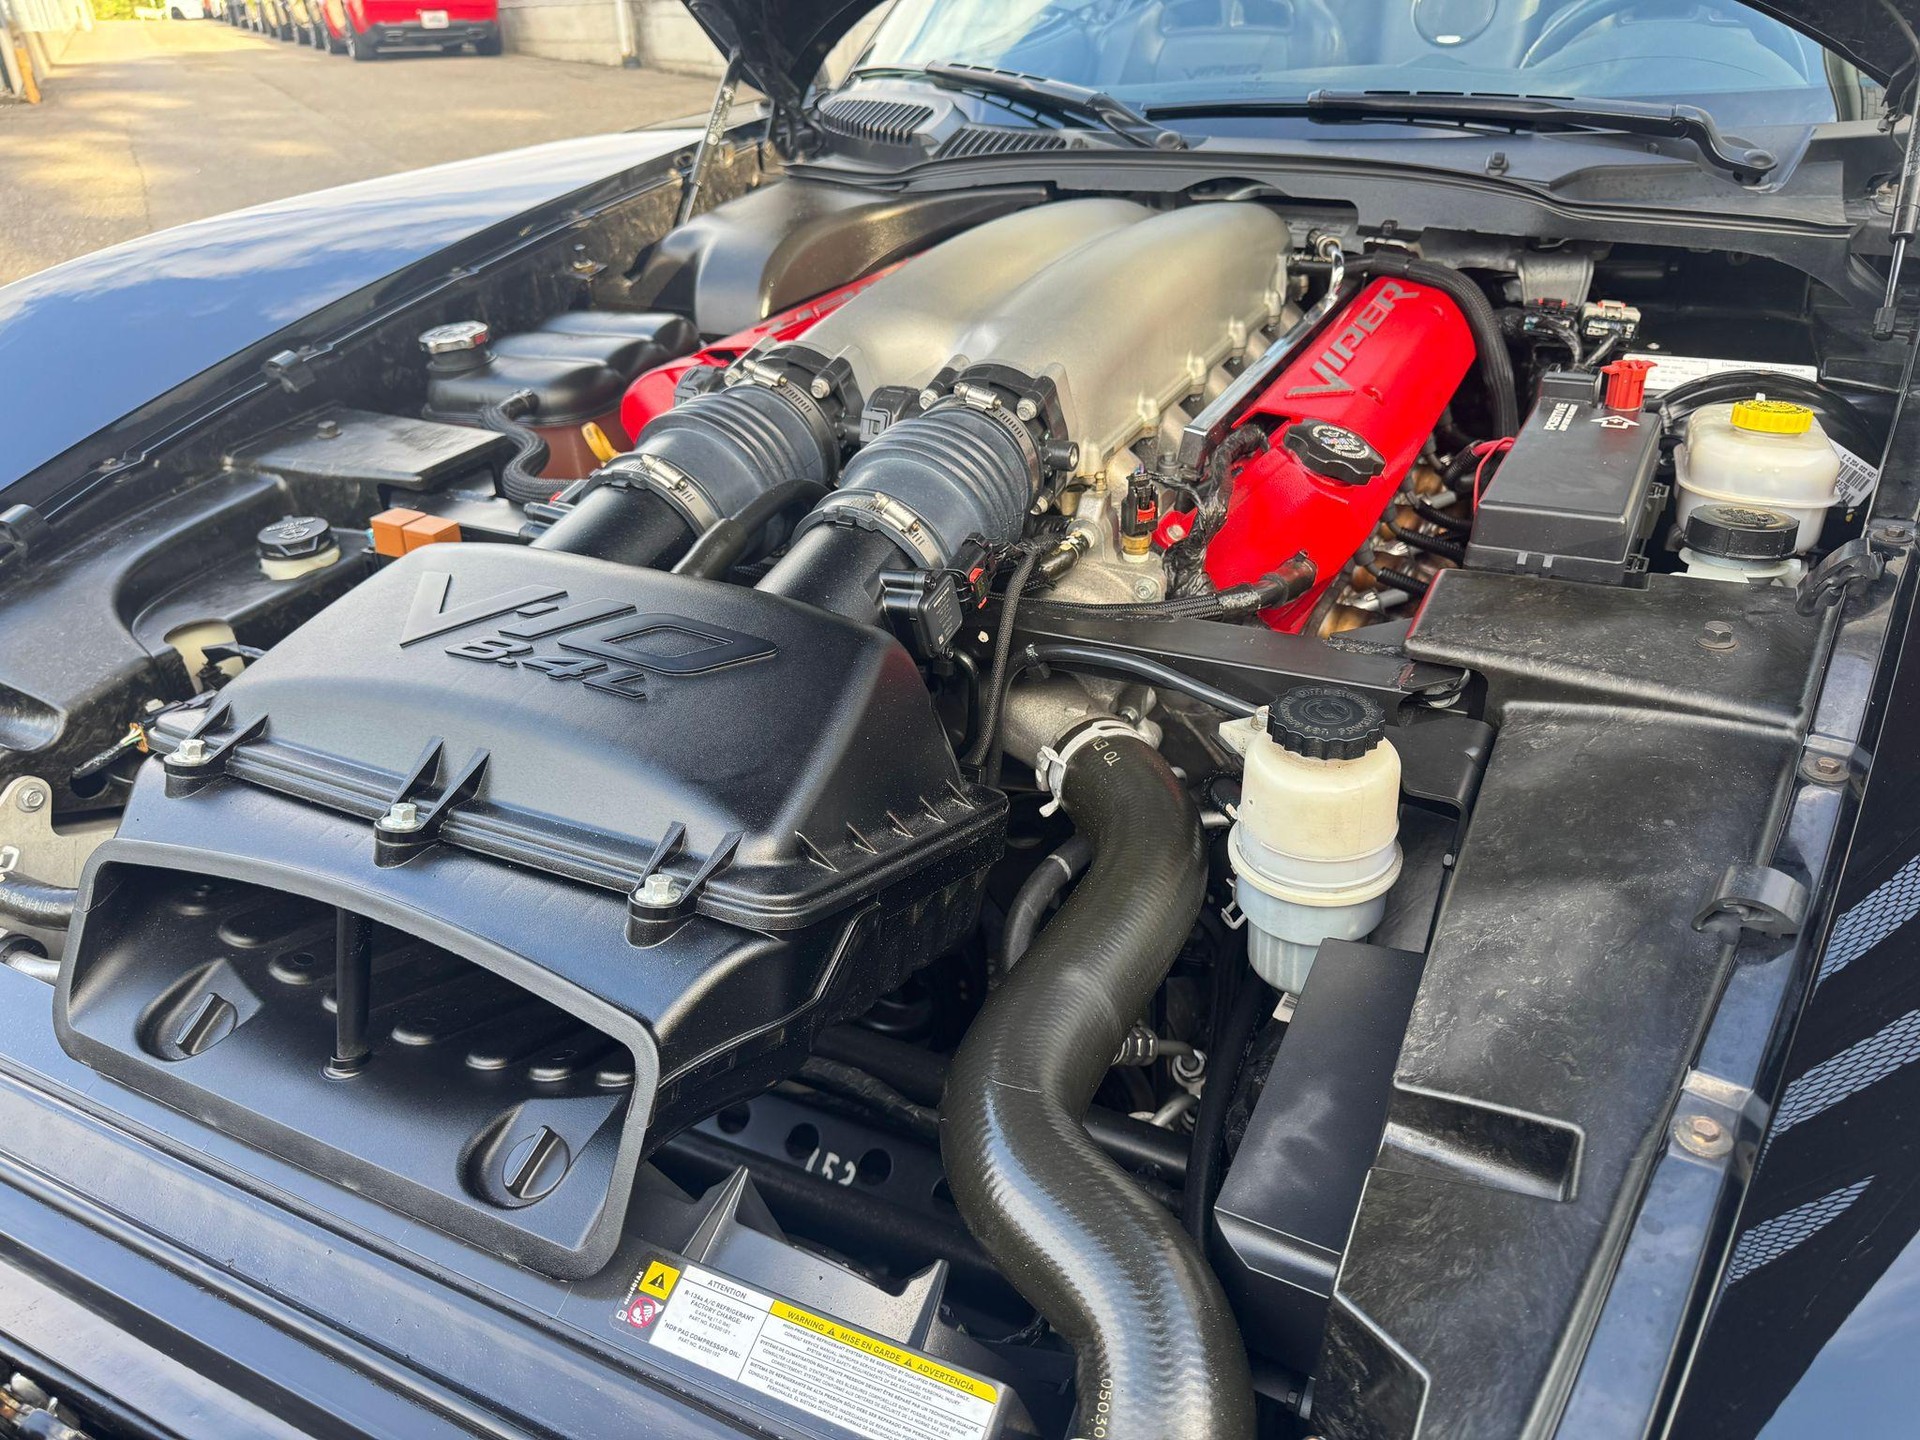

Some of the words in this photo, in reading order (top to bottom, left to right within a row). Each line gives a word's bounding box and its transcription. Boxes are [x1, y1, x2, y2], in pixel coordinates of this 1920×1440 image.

[1285, 281, 1420, 398] VIPER
[707, 1279, 747, 1299] ATTENTION
[684, 1289, 704, 1301] R-134a
[703, 1297, 716, 1307] A/C
[715, 1302, 755, 1322] REFRIGERANT
[688, 1314, 700, 1322] PART
[690, 1299, 716, 1313] FACTORY
[715, 1310, 742, 1324] CHARGE:
[676, 1327, 689, 1336] PAG
[688, 1332, 729, 1353] COMPRESSOR
[727, 1349, 741, 1358] OIL:
[677, 1336, 689, 1344] PART
[786, 1310, 825, 1330] WARNING
[839, 1332, 860, 1345] MISE
[860, 1340, 872, 1350] EN
[872, 1345, 901, 1361] GARDE
[916, 1363, 976, 1391] ADVERTENCIA
[816, 1336, 845, 1350] REFRIGERANT
[903, 1372, 928, 1385] QUALIFIED
[1094, 1378, 1114, 1438] 05030
